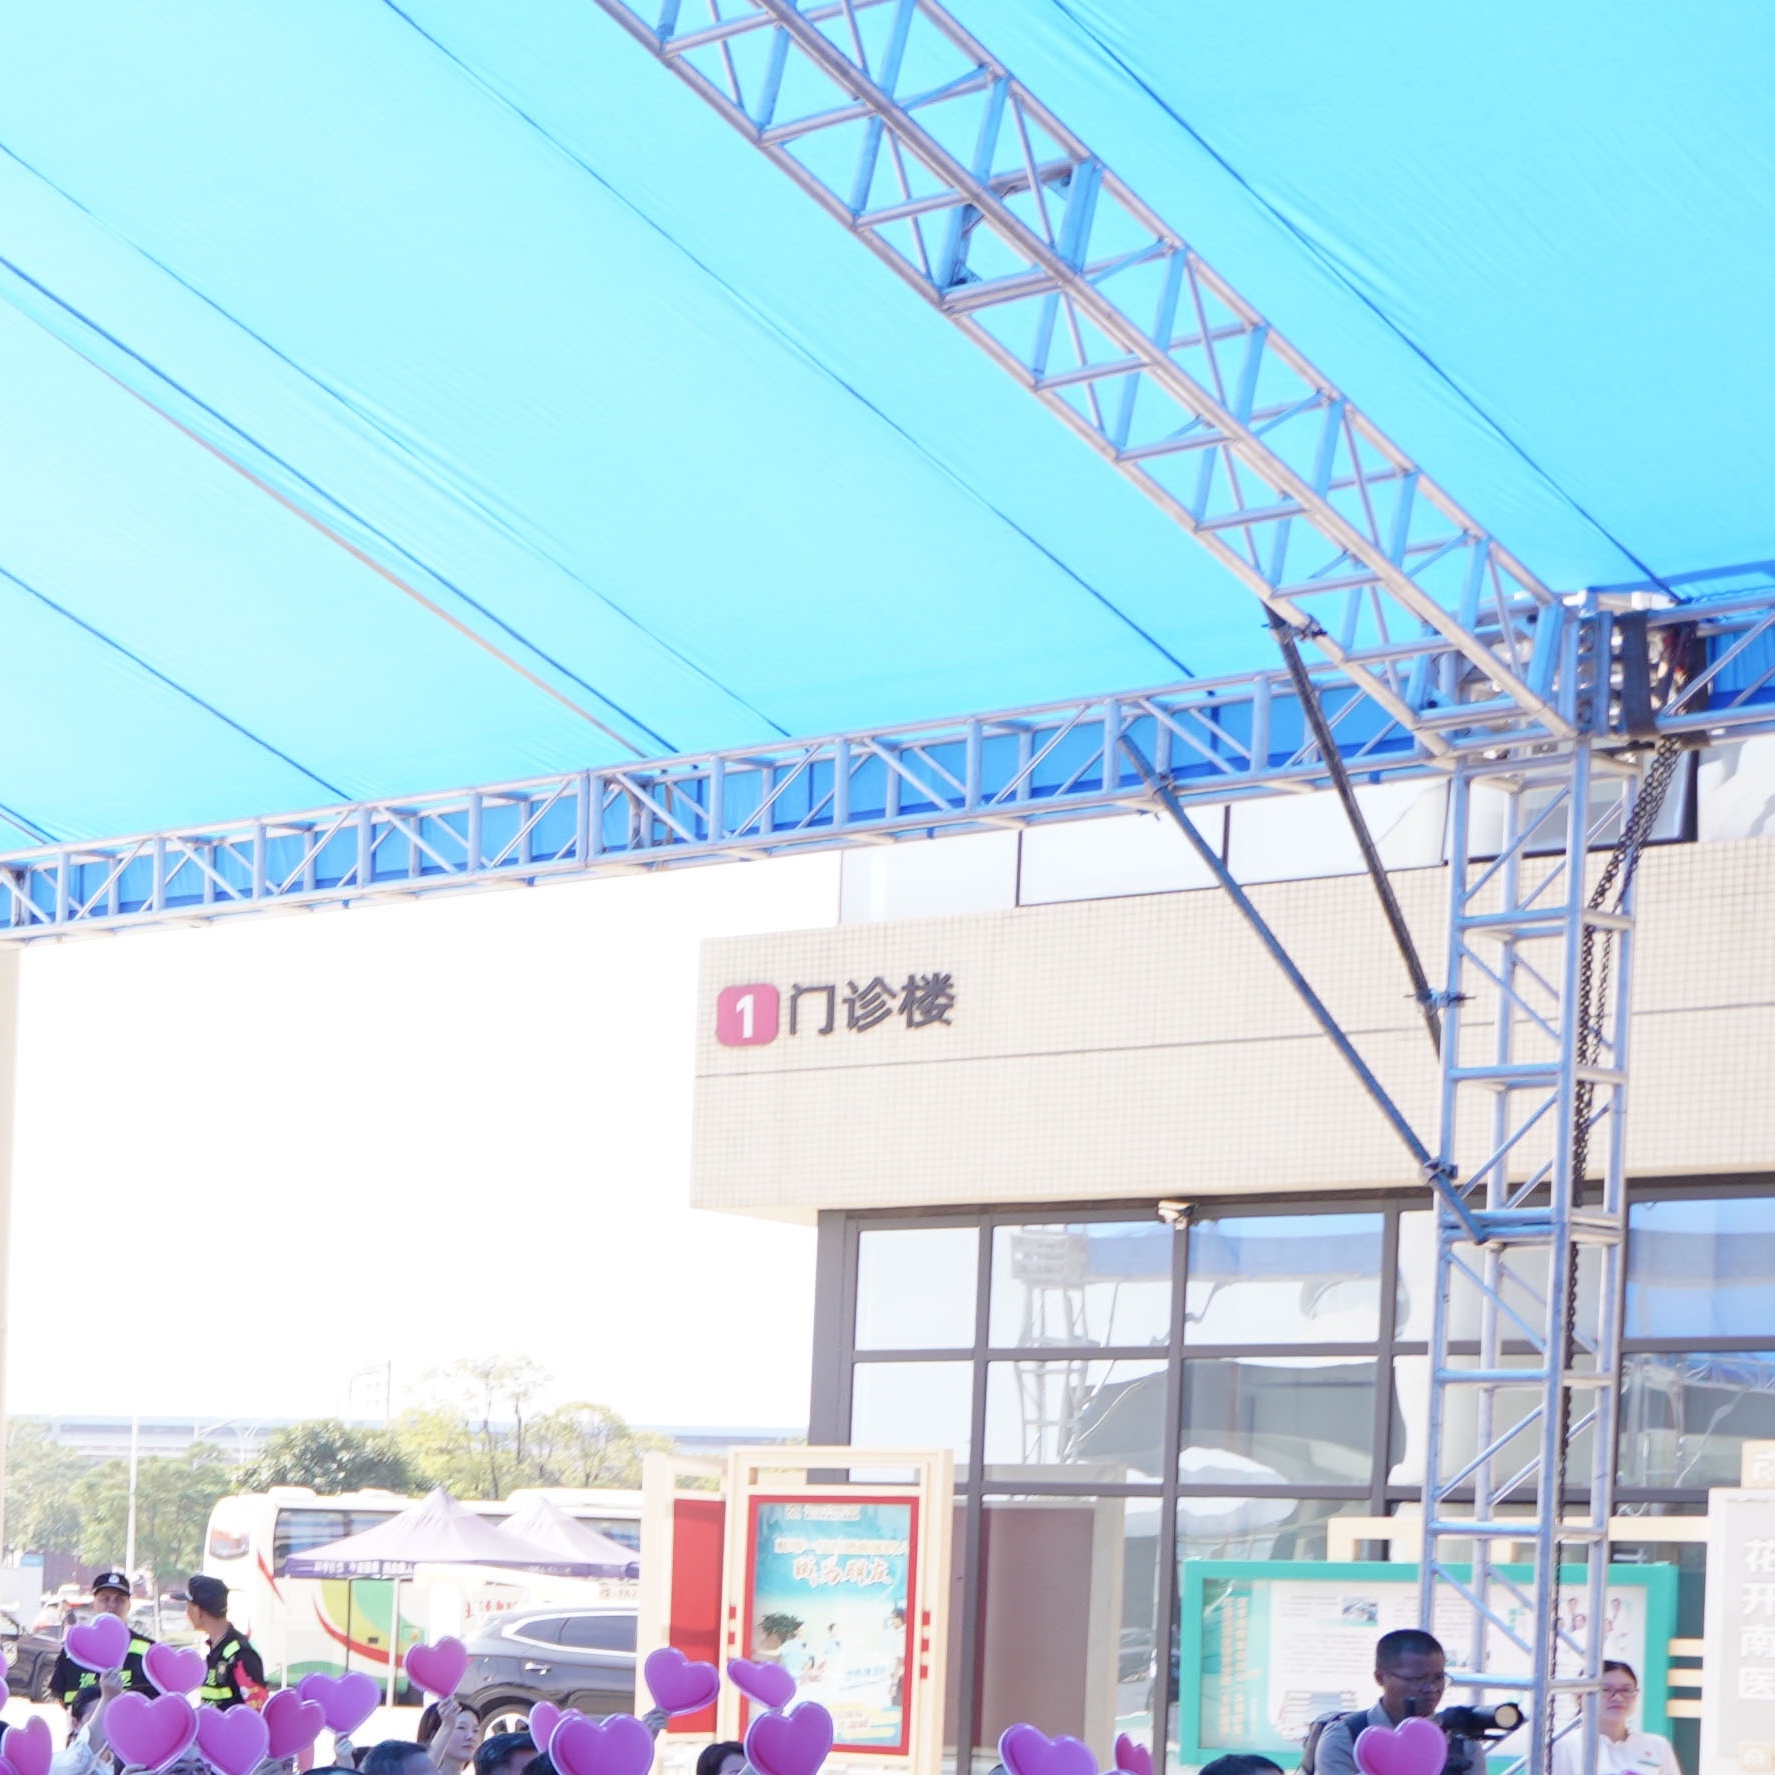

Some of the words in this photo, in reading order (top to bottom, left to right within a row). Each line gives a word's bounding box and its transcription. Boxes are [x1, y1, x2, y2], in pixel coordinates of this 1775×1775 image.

[734, 993, 755, 1039] 1
[789, 971, 956, 1036] 门诊楼
